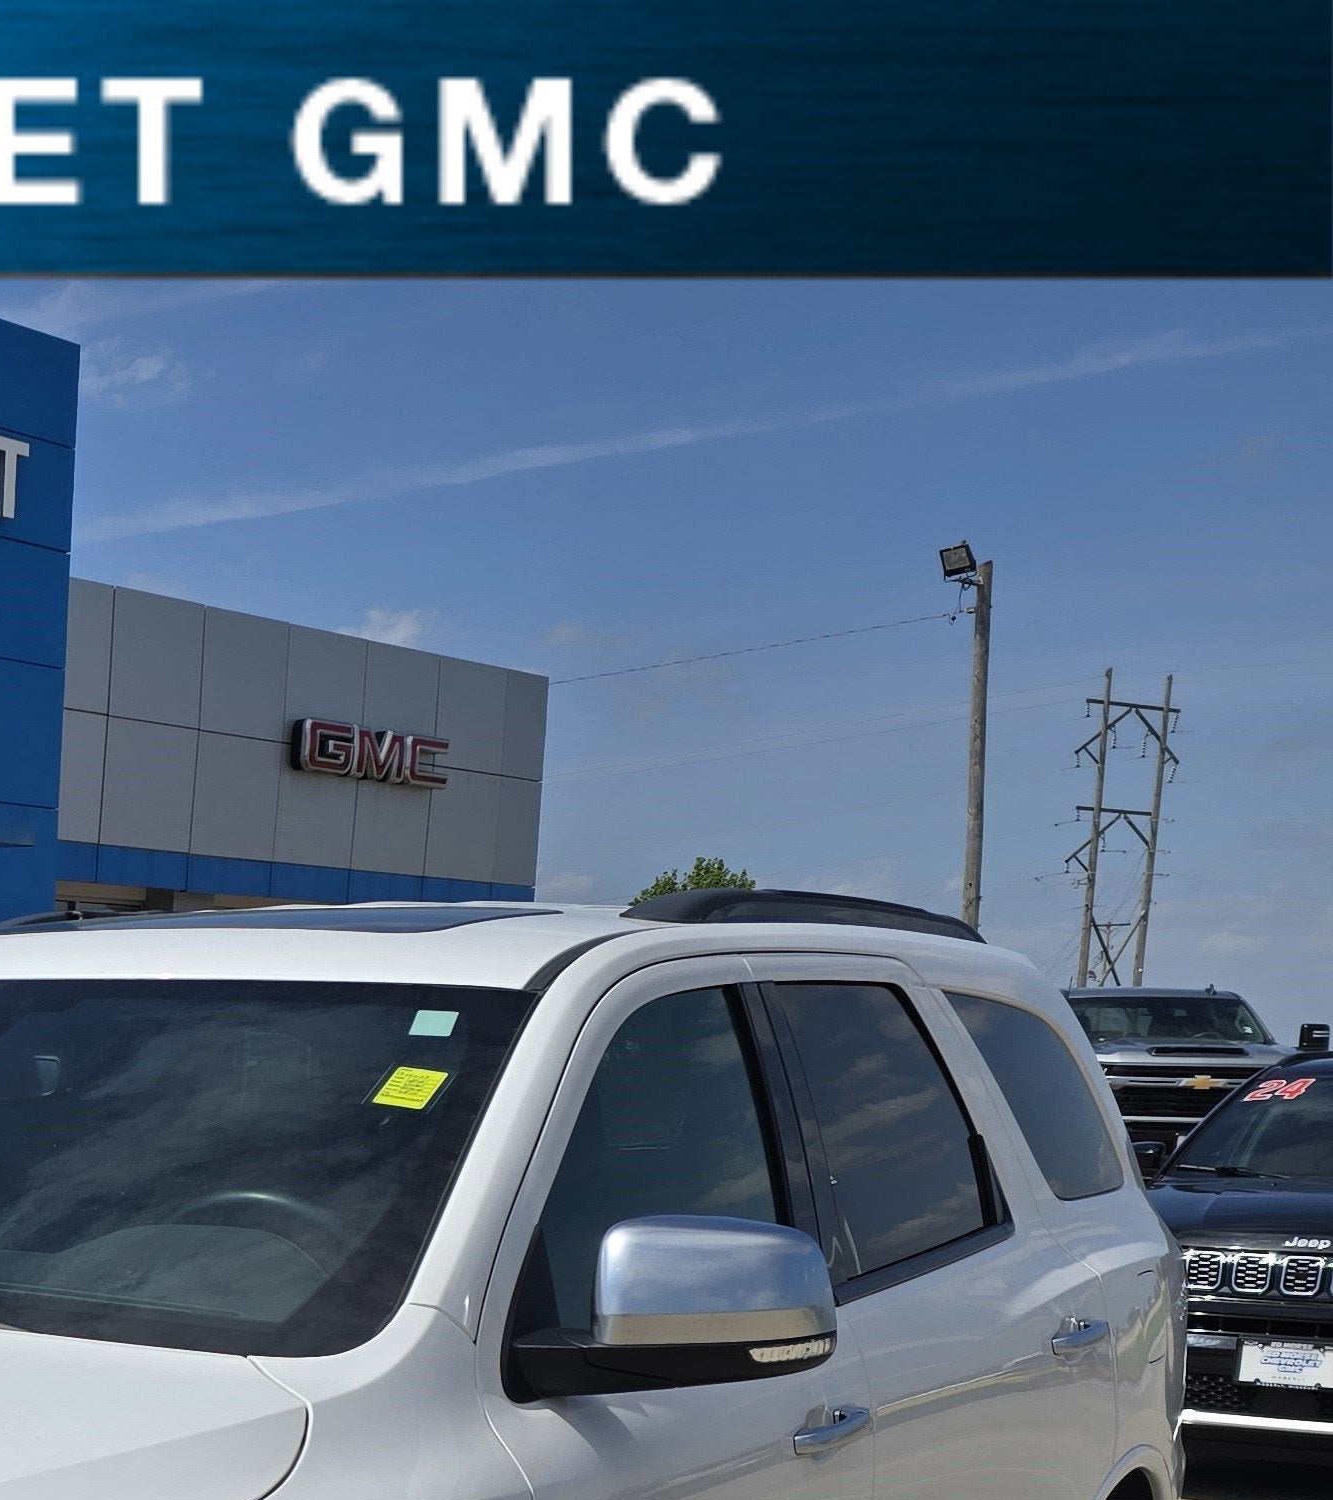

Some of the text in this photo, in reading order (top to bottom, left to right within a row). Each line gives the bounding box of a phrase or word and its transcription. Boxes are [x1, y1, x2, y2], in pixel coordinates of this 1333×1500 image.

[292, 717, 450, 790] GMC
[1243, 1077, 1317, 1102] 24
[1284, 1236, 1331, 1250] Jeep
